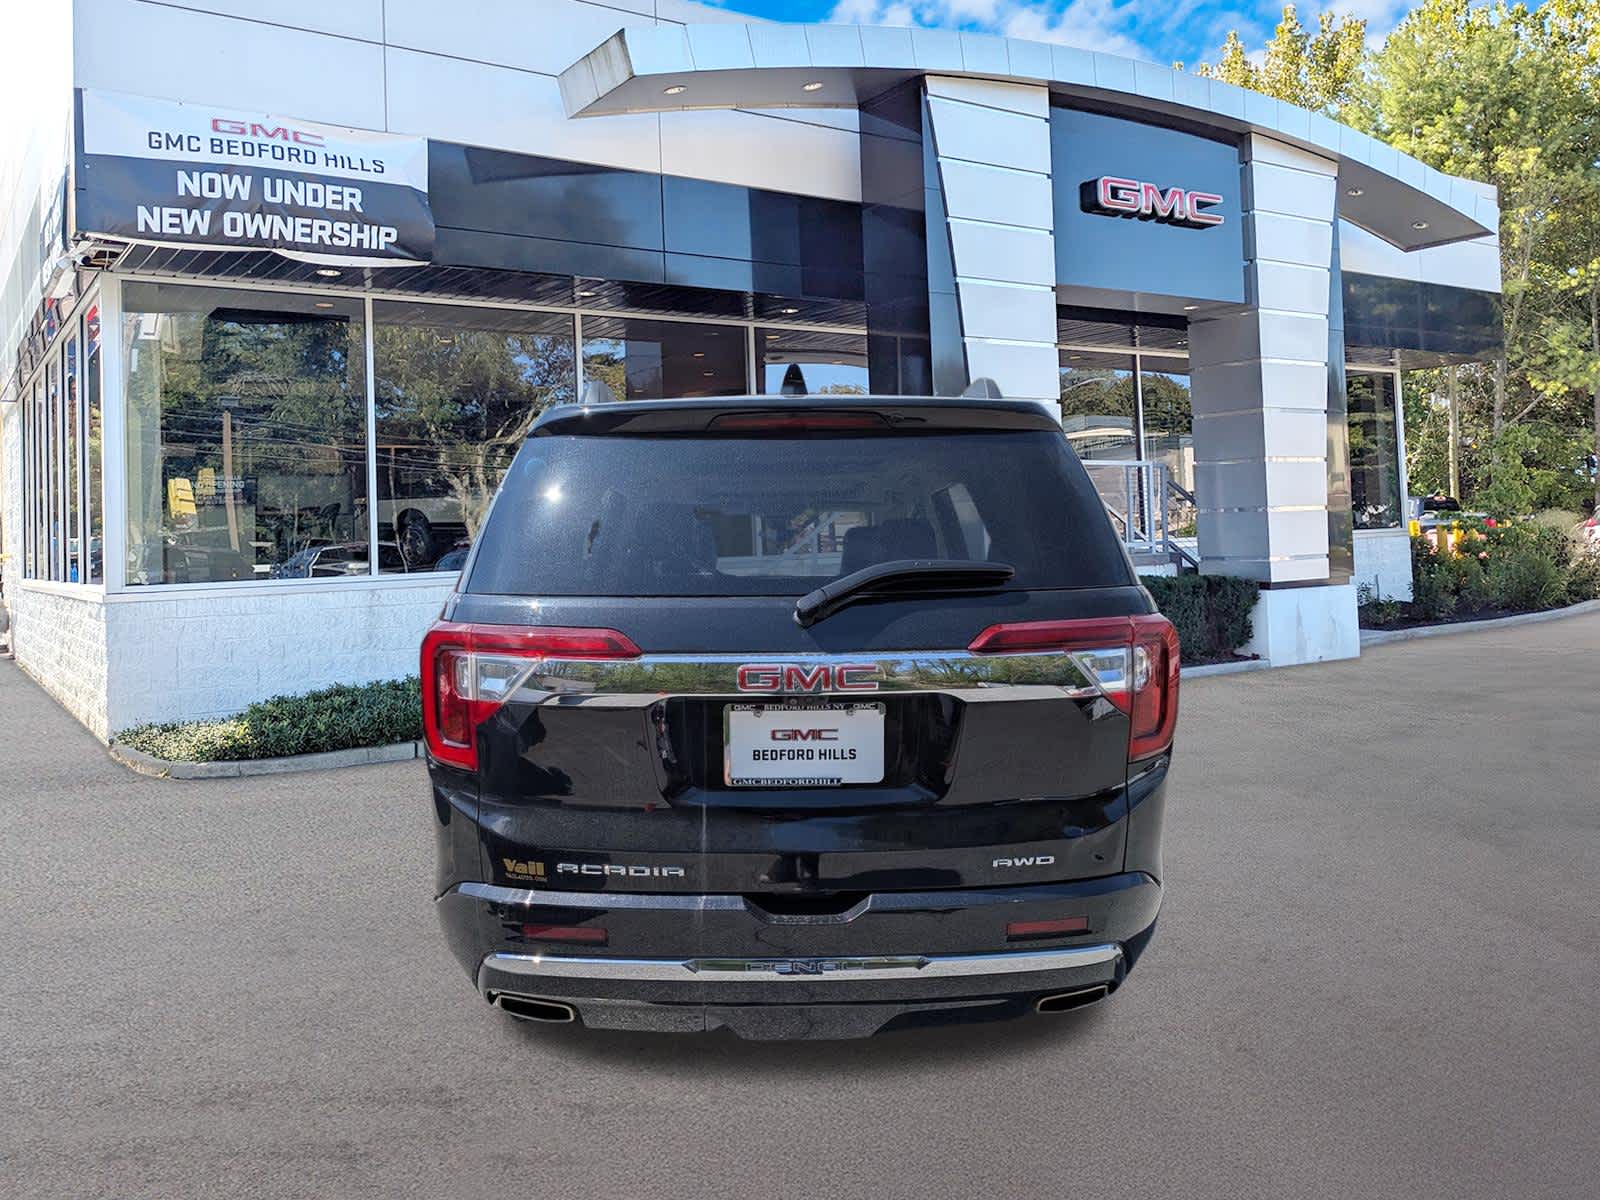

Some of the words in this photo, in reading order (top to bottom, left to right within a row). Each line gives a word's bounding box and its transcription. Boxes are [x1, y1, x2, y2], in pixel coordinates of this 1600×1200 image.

[211, 118, 326, 148] GMC
[148, 131, 200, 152] GMC
[210, 138, 317, 165] BEDFORD
[324, 153, 385, 174] HILLS
[176, 170, 252, 201] NOW
[263, 176, 364, 213] UNDER
[1098, 175, 1225, 224] GMC
[136, 205, 212, 236] NEW
[223, 211, 398, 250] OWNERSHIP
[737, 664, 880, 692] GMC
[771, 728, 839, 741] GMC
[753, 749, 814, 761] BEDFORD
[819, 749, 857, 760] HILLS
[556, 863, 685, 877] ACADIA
[992, 855, 1055, 868] AWD
